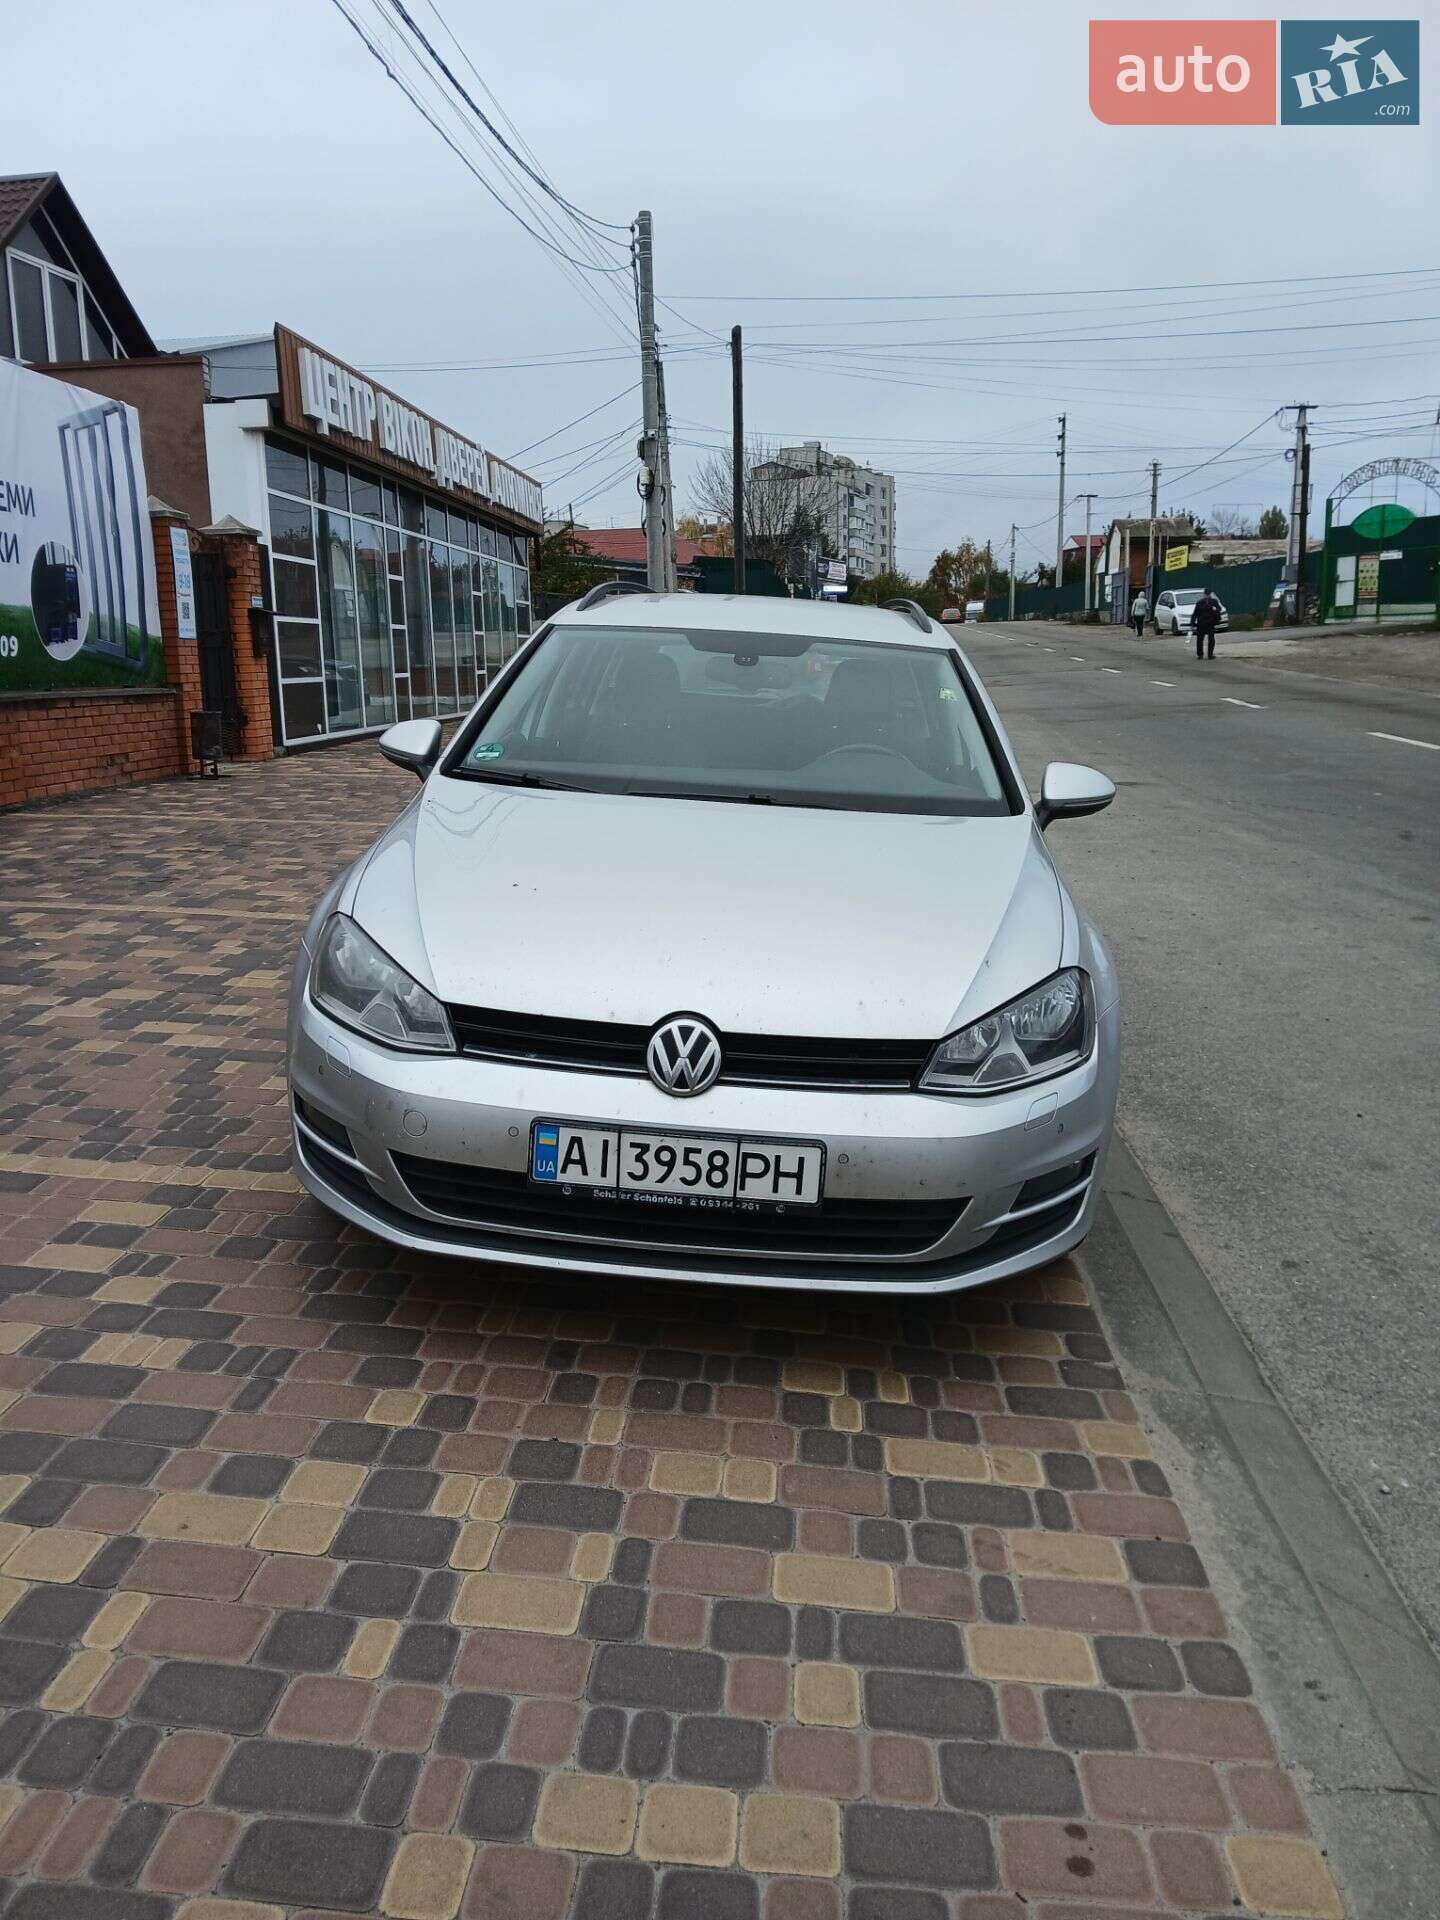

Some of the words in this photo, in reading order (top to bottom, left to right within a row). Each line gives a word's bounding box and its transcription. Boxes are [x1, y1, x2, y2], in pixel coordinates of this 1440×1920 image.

[298, 347, 376, 443] ЦЕНТР
[537, 1160, 555, 1175] UA
[560, 1136, 610, 1179] AI
[627, 1142, 729, 1189] 3958
[739, 1151, 805, 1196] PH
